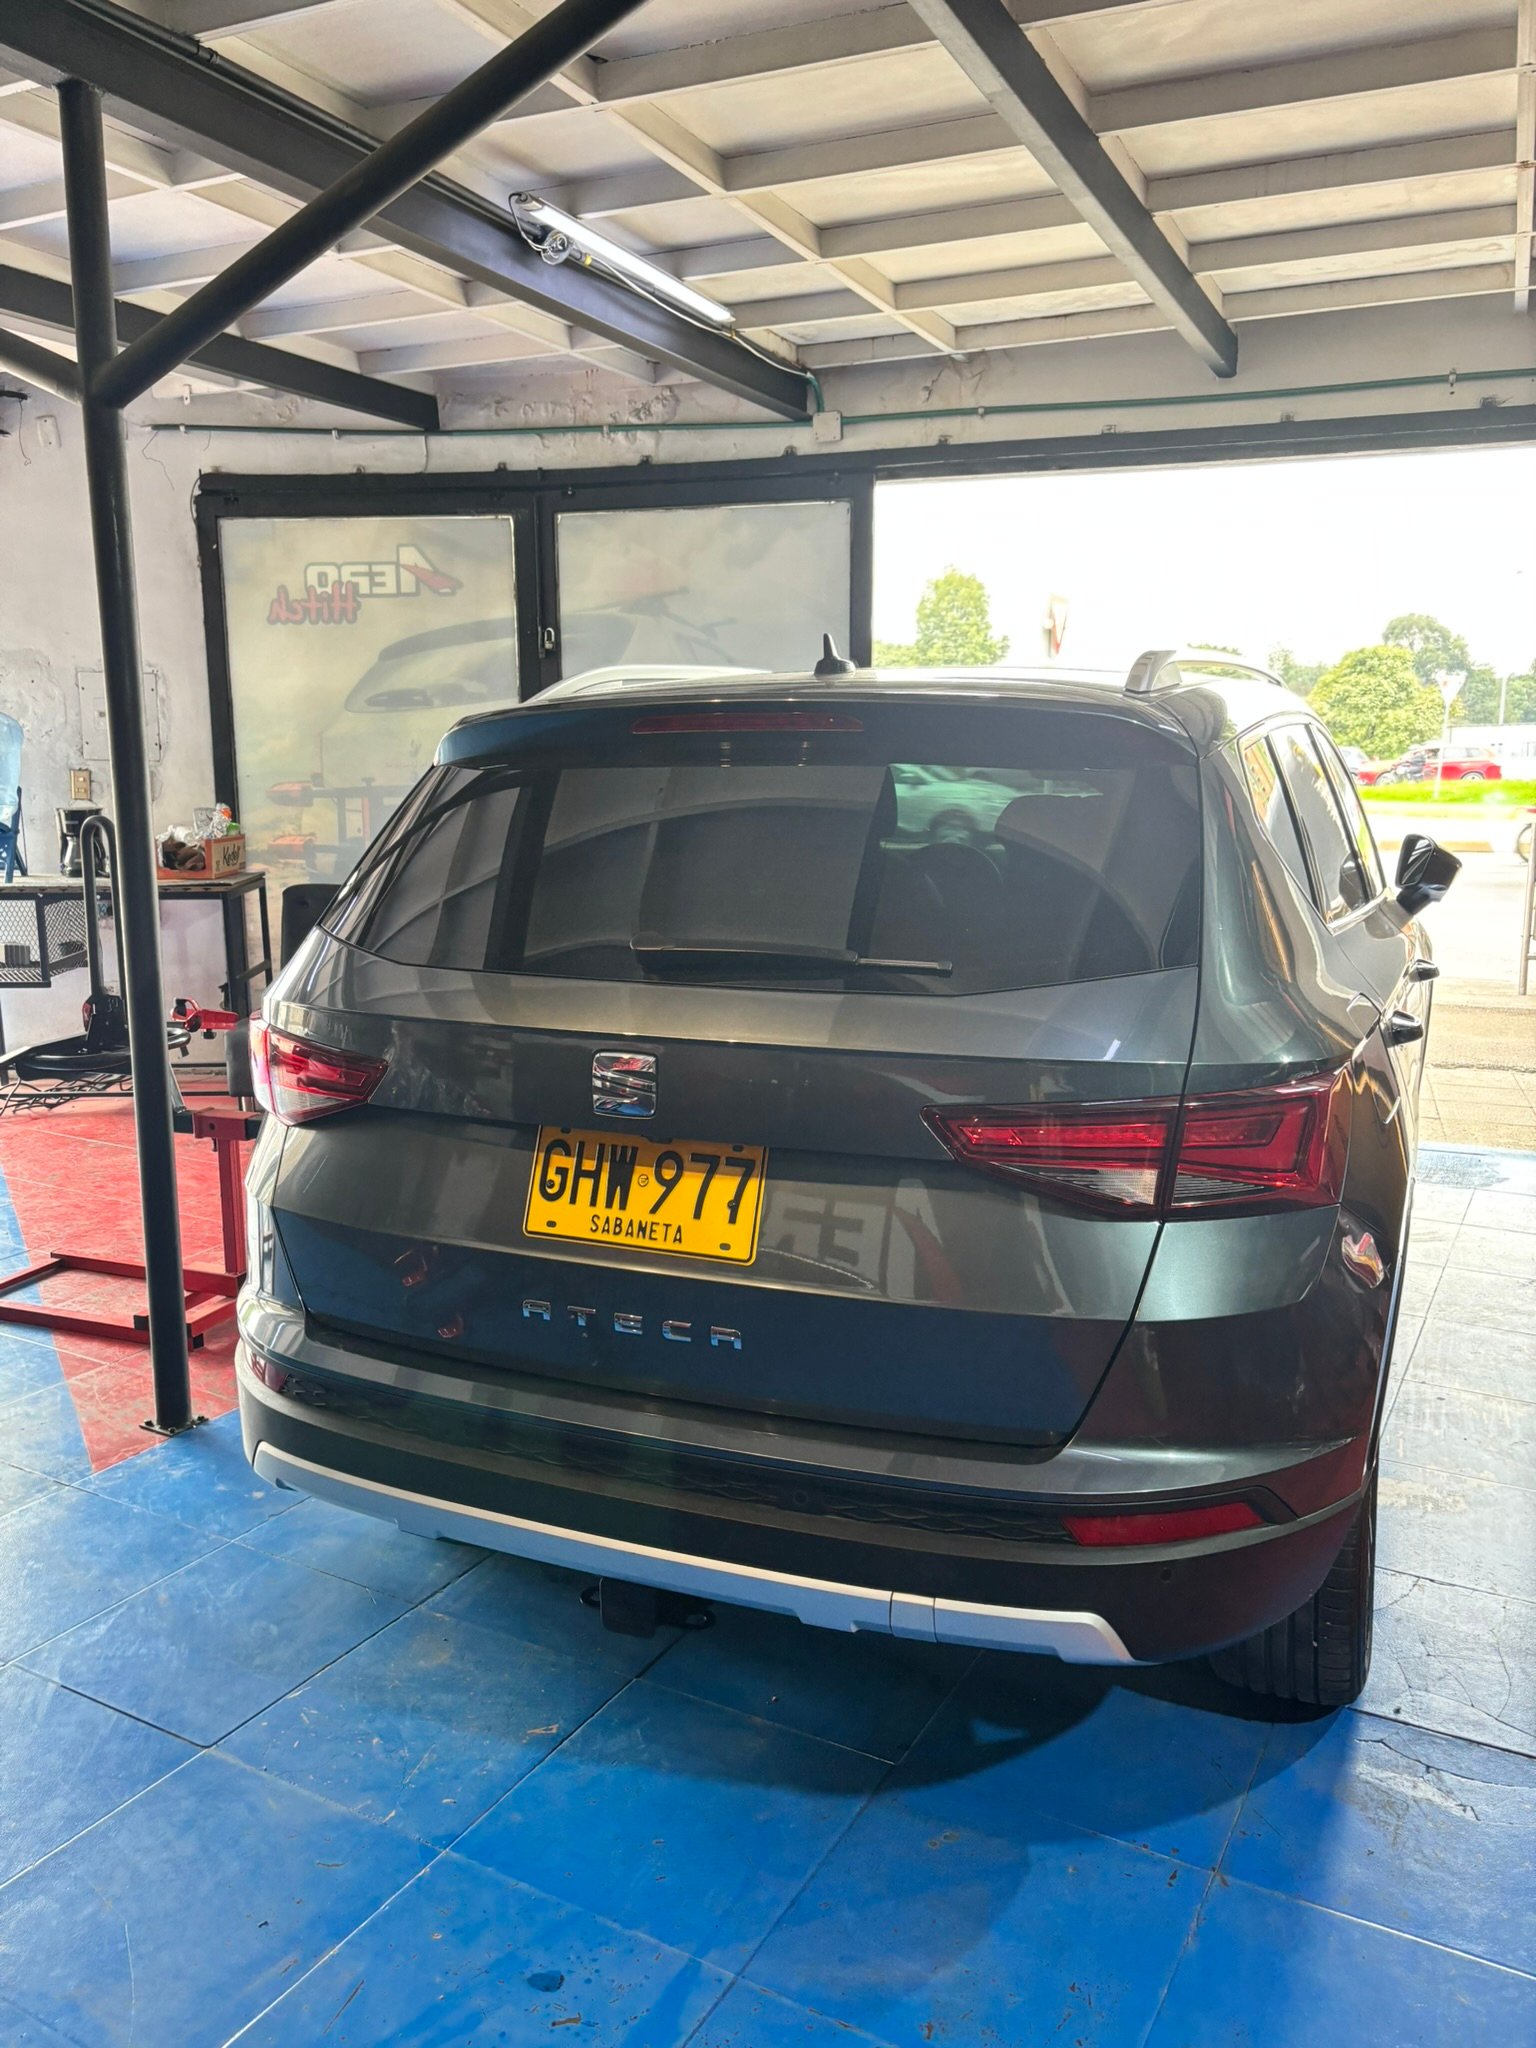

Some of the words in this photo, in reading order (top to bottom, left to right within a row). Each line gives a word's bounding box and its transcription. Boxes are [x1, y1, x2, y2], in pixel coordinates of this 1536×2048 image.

[538, 1138, 639, 1211] GHW
[649, 1150, 756, 1225] 977
[590, 1214, 683, 1244] SABANETA
[522, 1299, 742, 1350] ATECA
